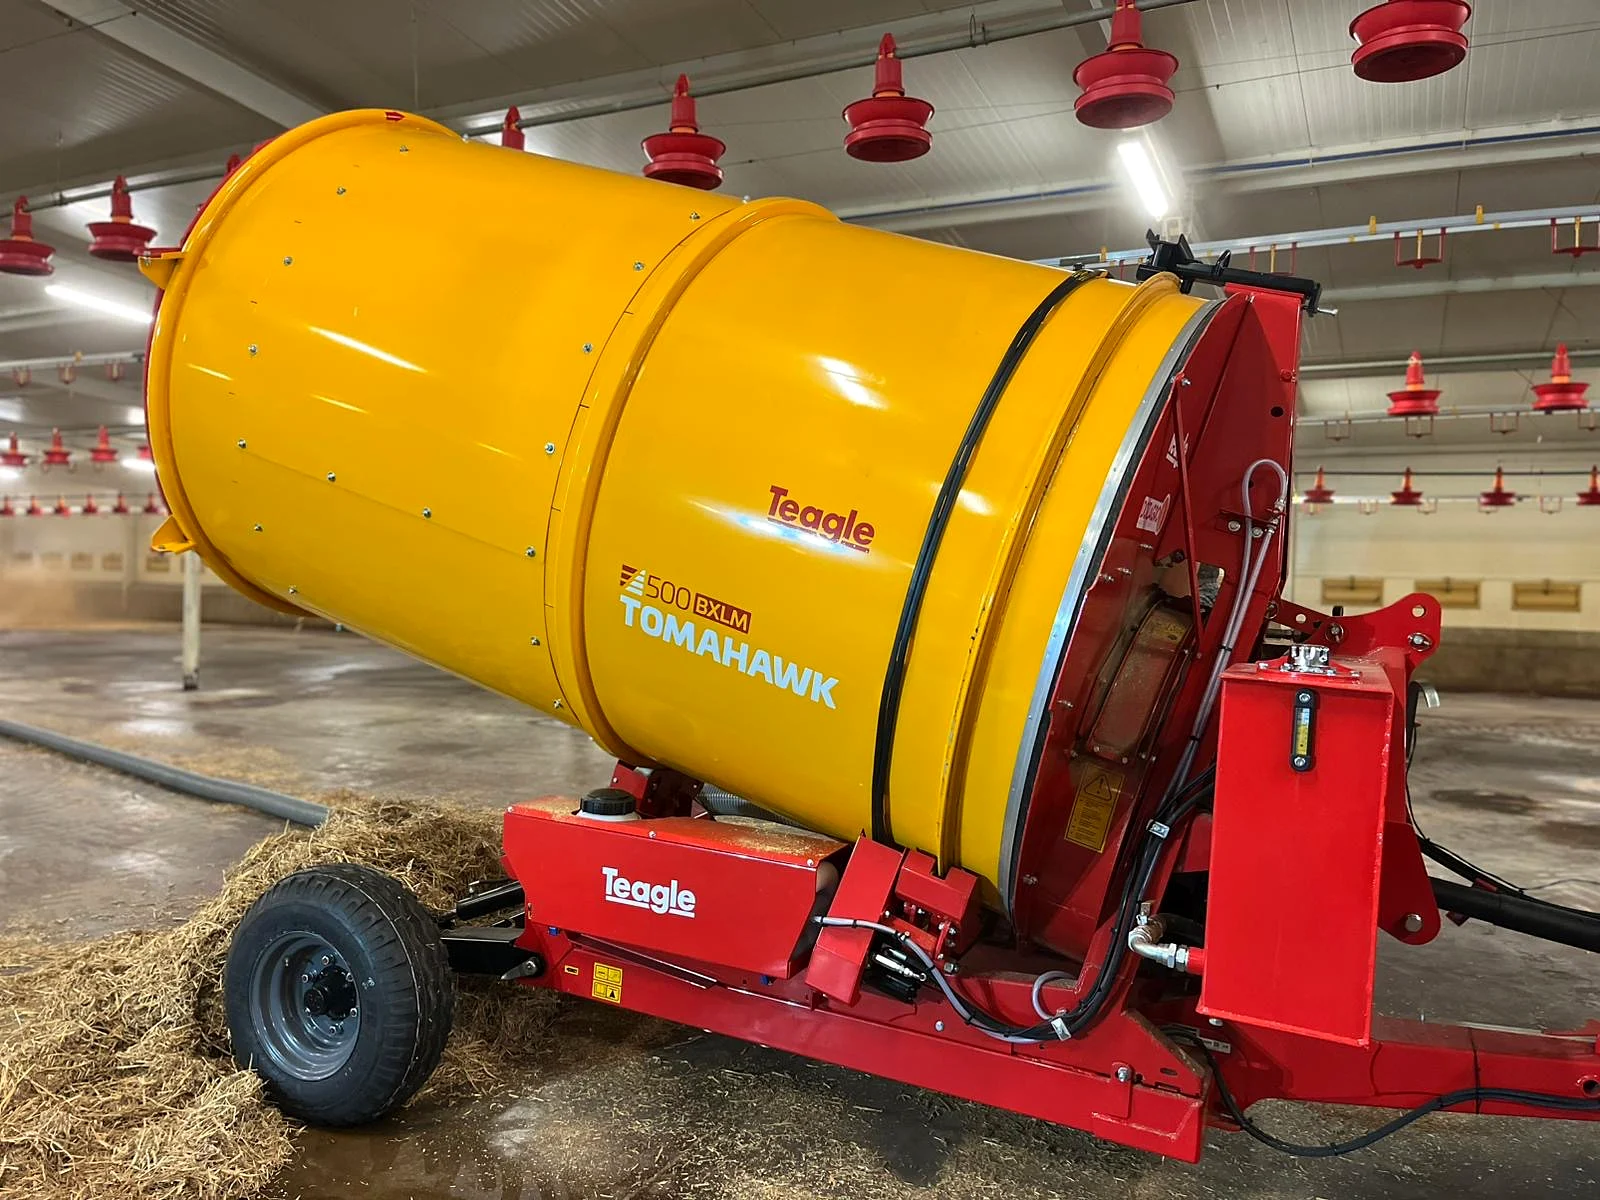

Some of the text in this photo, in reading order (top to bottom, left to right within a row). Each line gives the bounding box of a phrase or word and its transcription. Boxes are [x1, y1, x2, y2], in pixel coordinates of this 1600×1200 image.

[768, 485, 875, 550] Teagle
[646, 574, 749, 631] 500 BXLM
[619, 594, 839, 710] TOMAHAWK
[602, 866, 696, 915] Teagle
